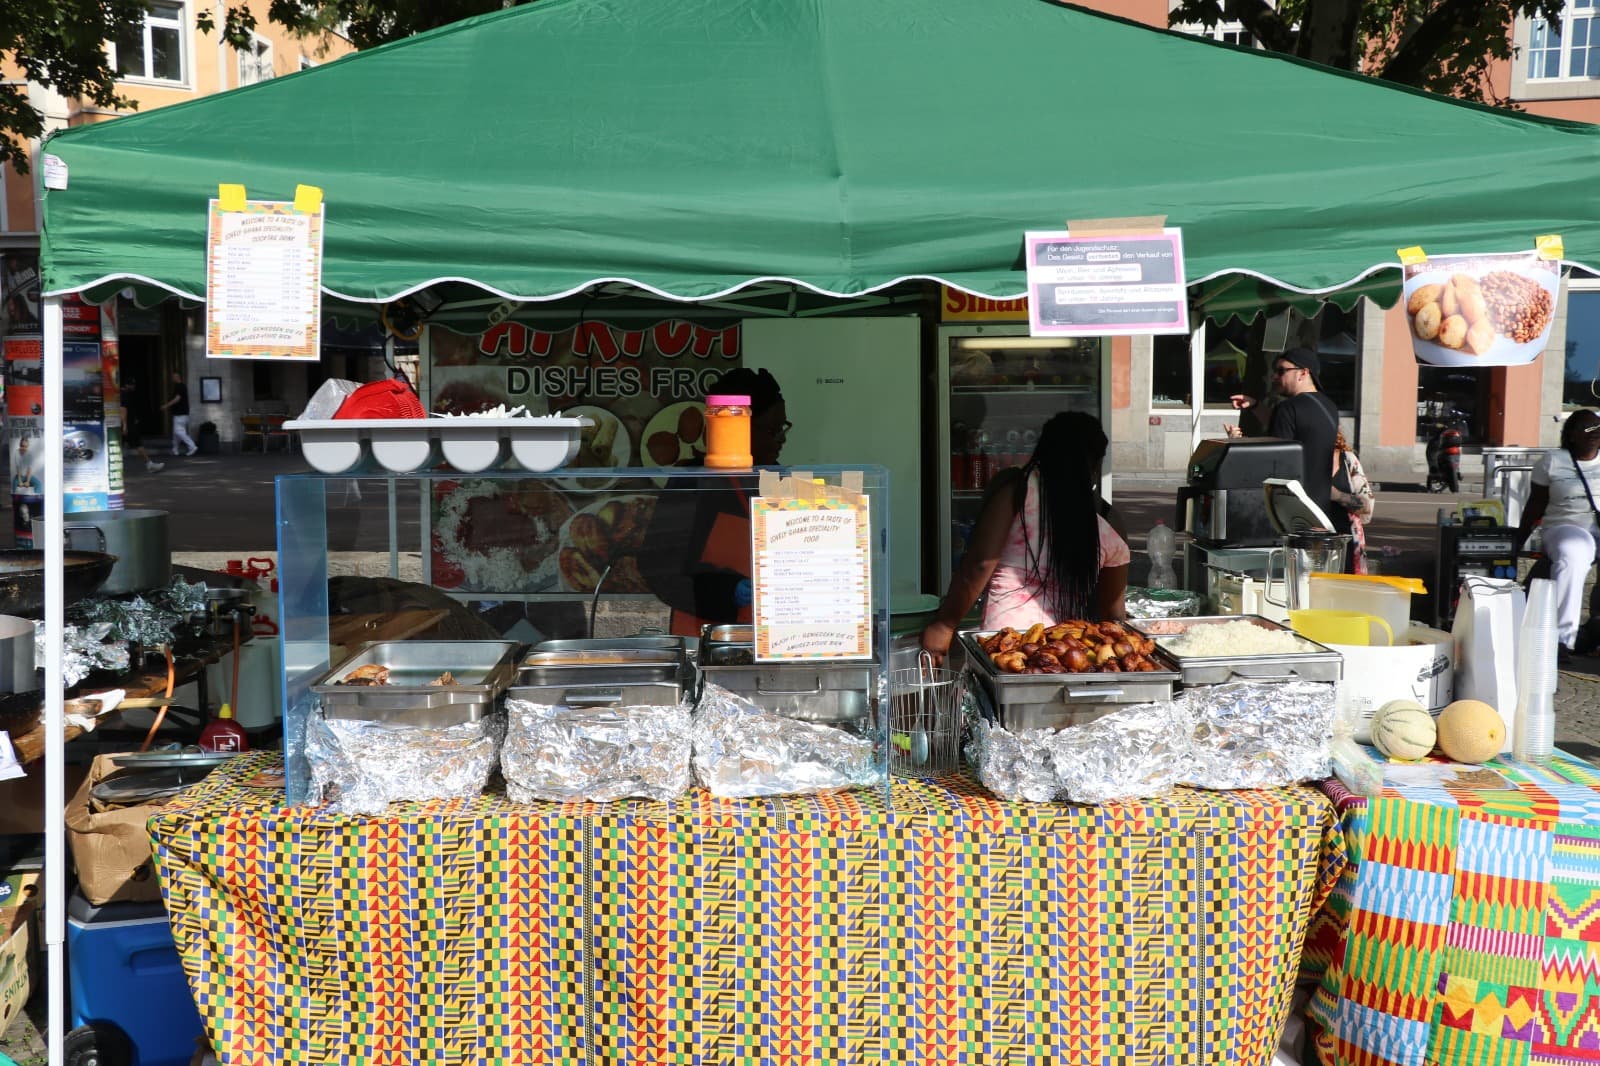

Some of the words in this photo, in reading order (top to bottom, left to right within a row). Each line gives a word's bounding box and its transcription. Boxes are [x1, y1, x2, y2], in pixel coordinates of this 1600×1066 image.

[507, 367, 642, 397] DISHES
[650, 367, 741, 397] FRO
[786, 515, 810, 527] WELCOME
[811, 514, 819, 522] TO
